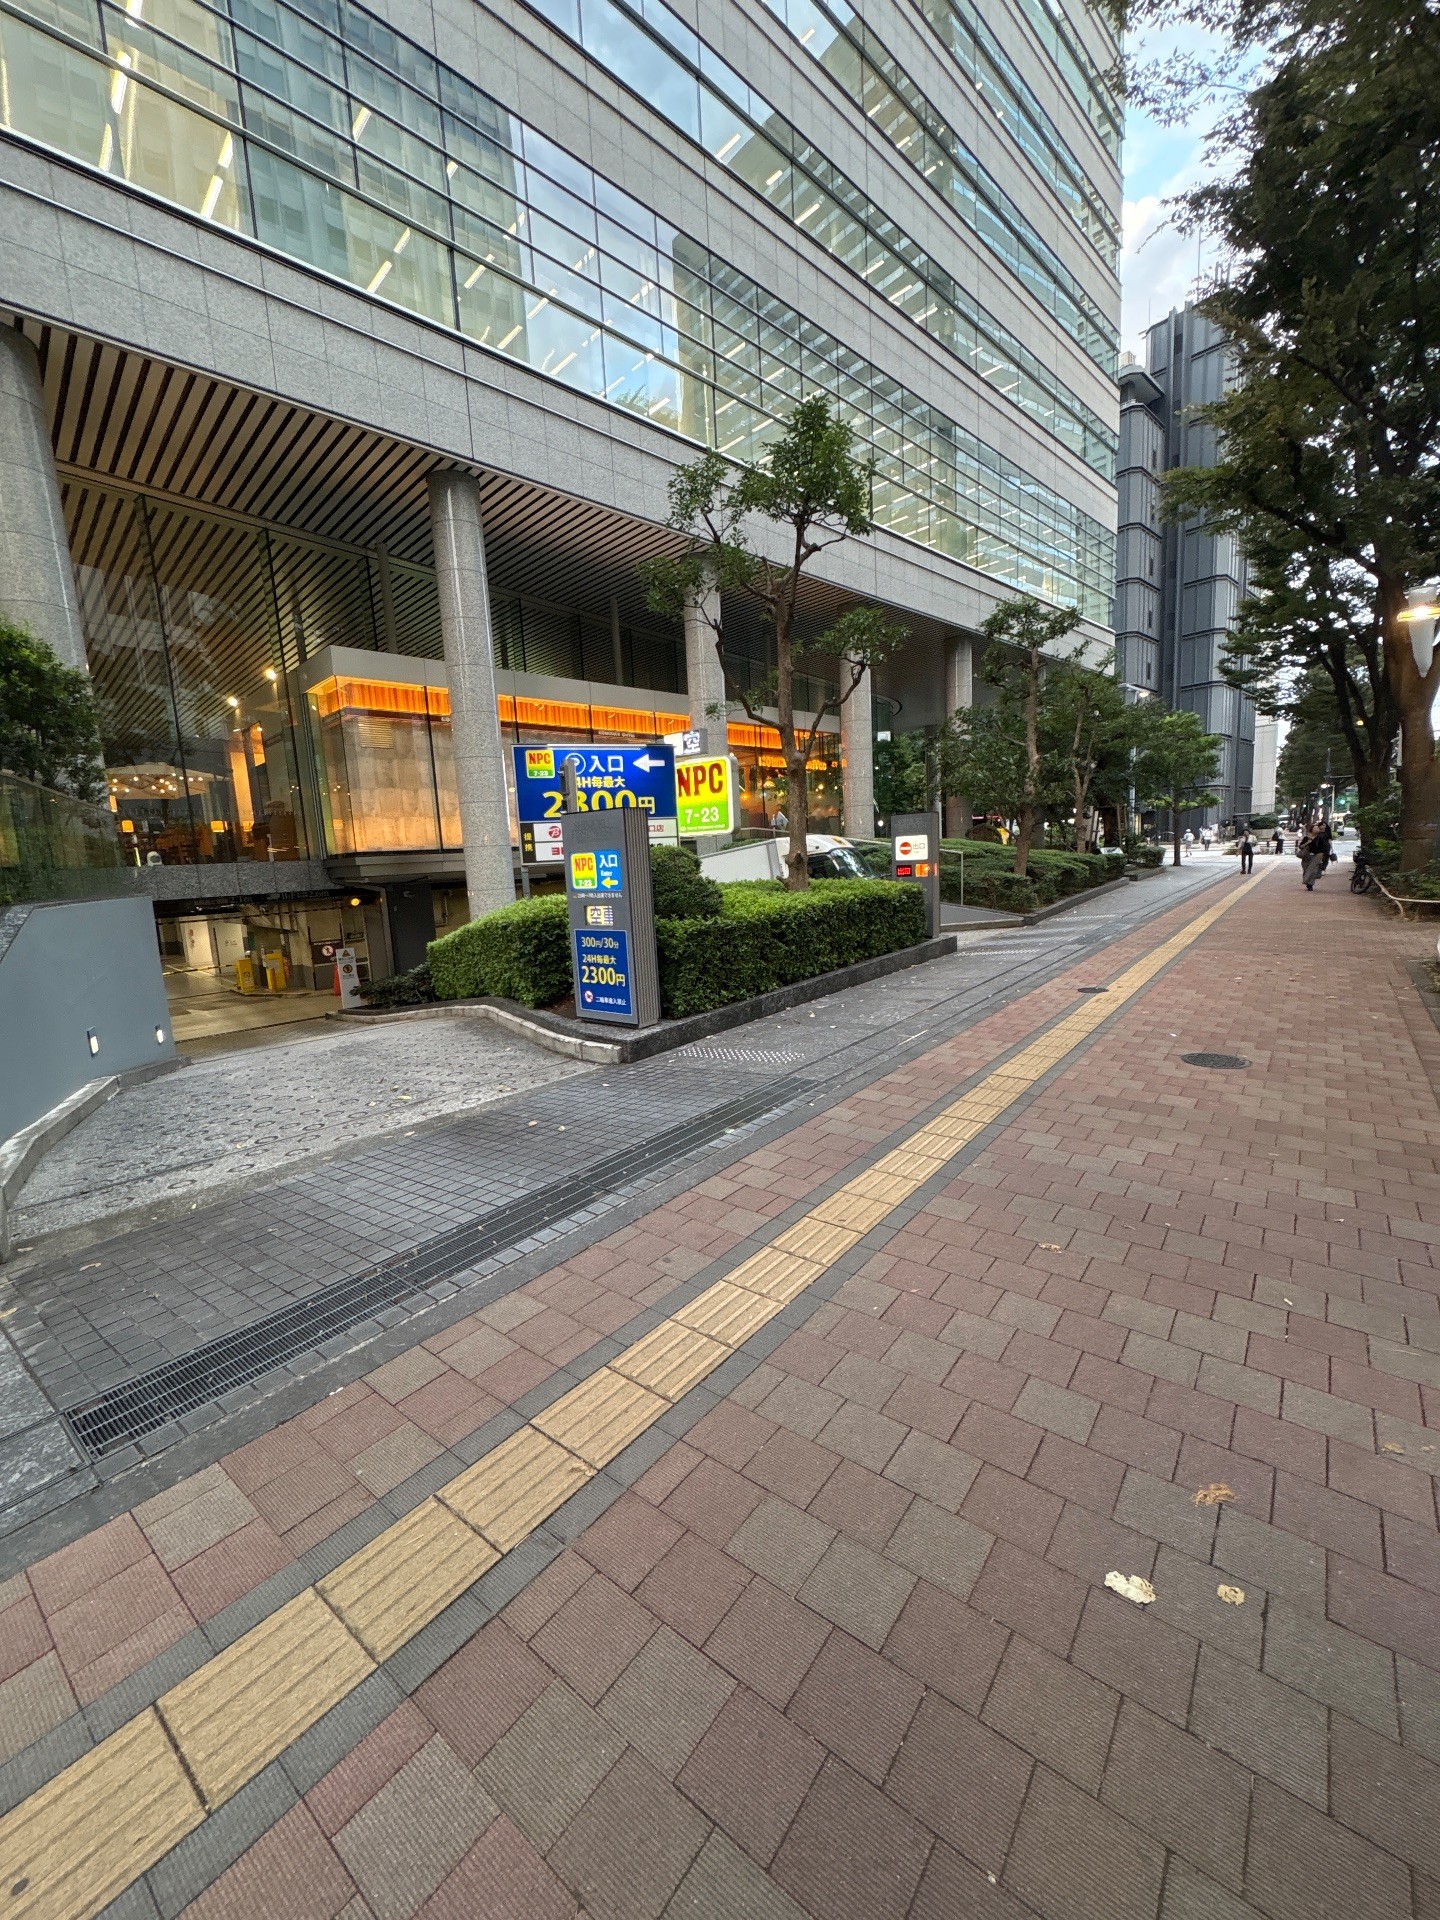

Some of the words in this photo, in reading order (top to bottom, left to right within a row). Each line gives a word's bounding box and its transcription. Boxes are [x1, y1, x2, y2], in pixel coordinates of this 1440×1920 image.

[528, 752, 551, 765] NPC
[588, 755, 624, 773] 入口
[575, 776, 626, 788] 4H毎最大
[676, 762, 723, 798] NPC
[684, 806, 720, 824] 7-23
[574, 857, 594, 871] NPC
[599, 854, 618, 868] 入口
[582, 953, 617, 965] 24H毎最大
[582, 965, 626, 987] 2300円
